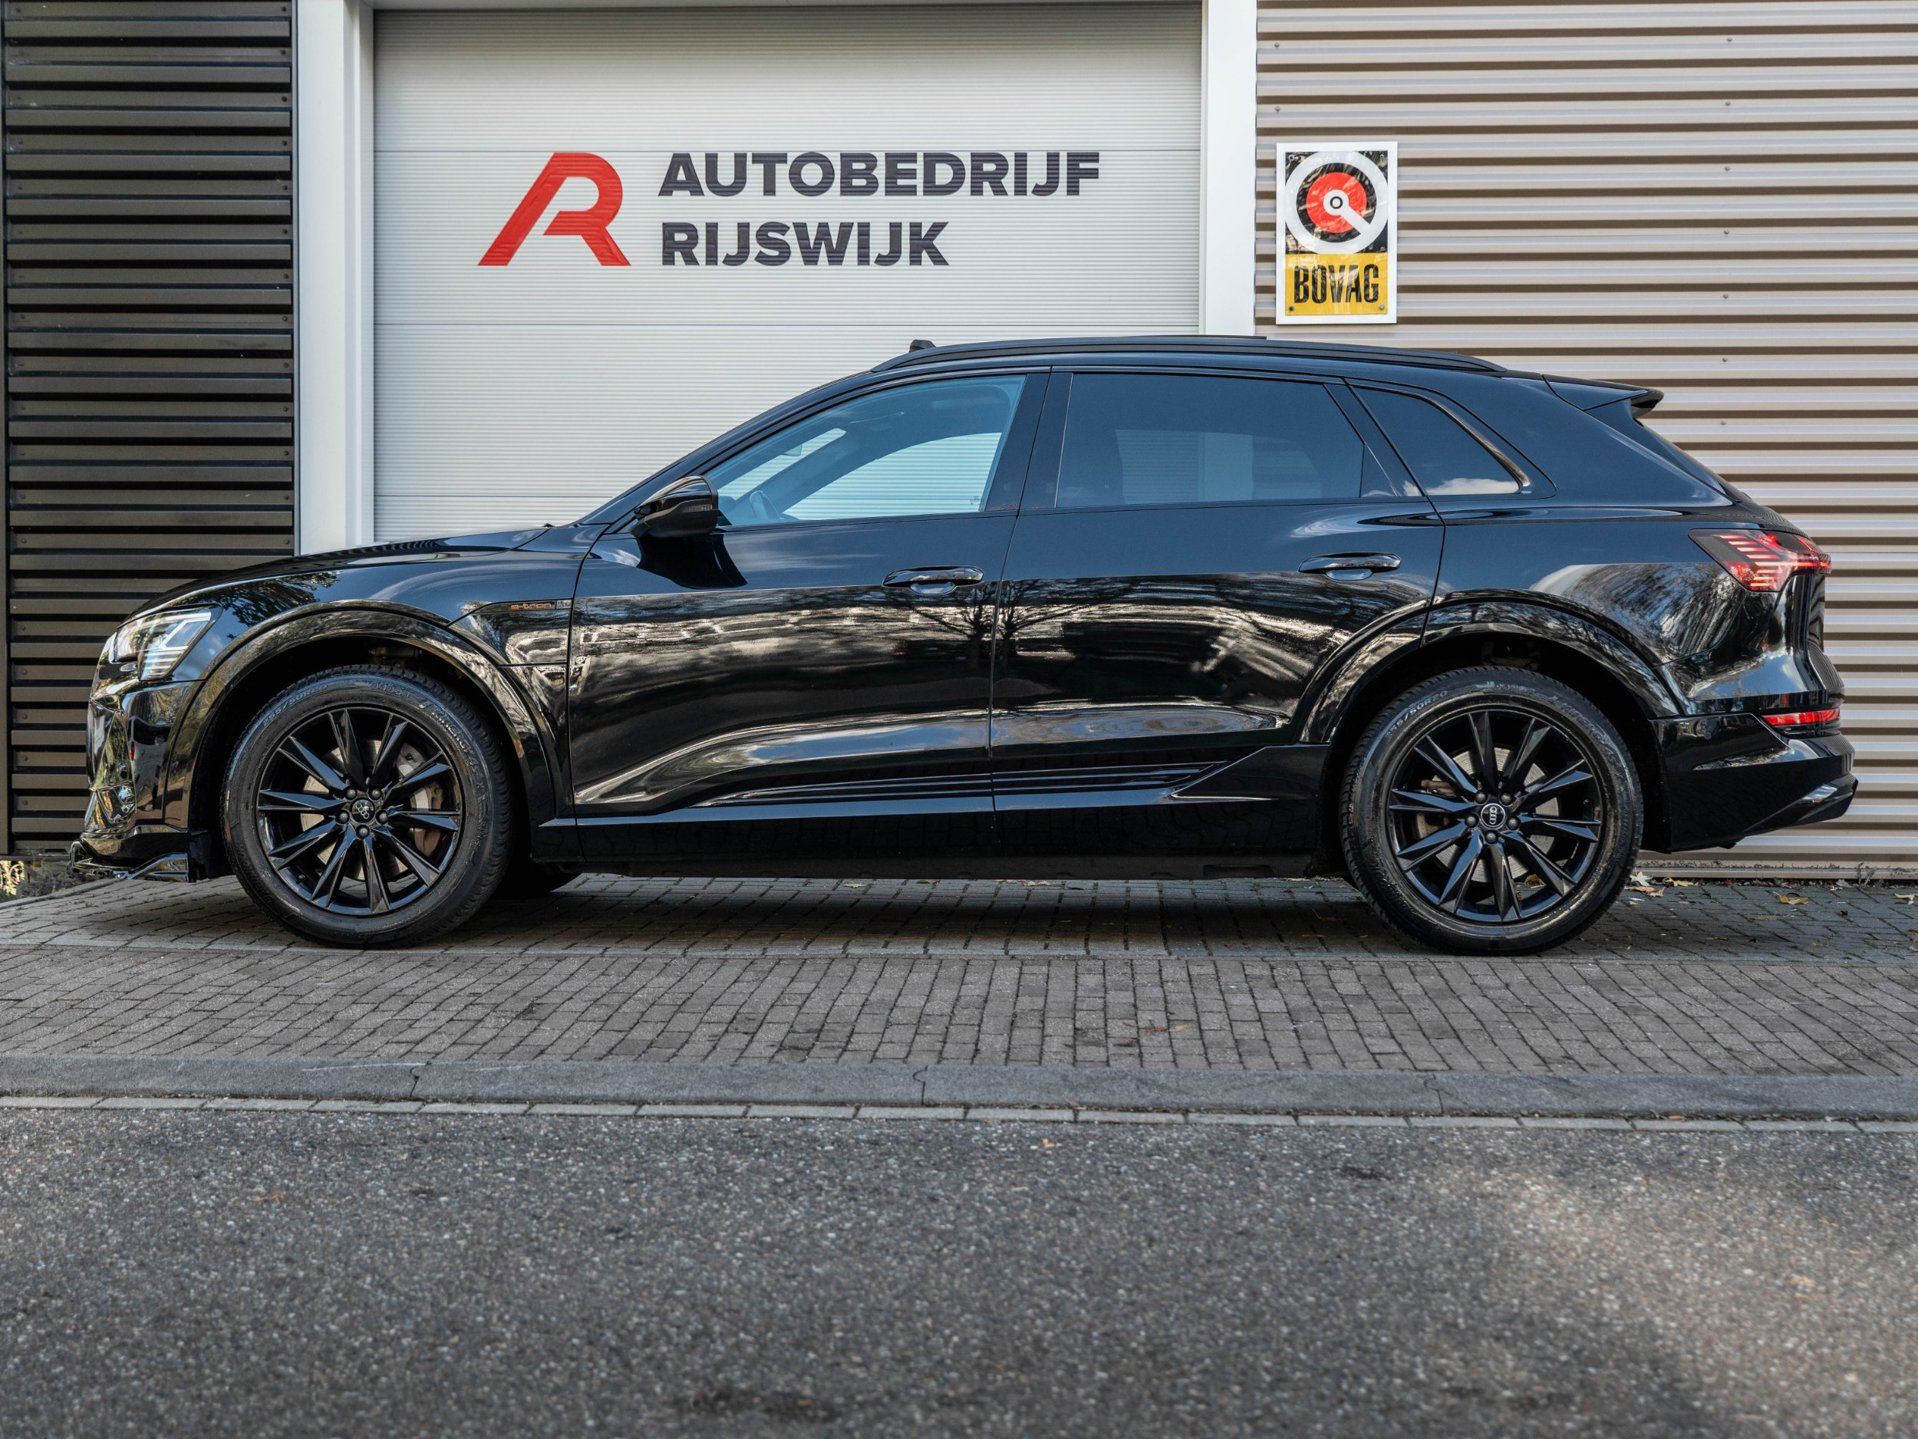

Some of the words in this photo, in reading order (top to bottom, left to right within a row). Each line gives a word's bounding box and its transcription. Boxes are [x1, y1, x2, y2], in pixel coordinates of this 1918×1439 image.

[658, 151, 1100, 197] AUTOBEDRIJF
[662, 221, 949, 266] RIJSWIJK
[1293, 264, 1379, 304] BOVAG
